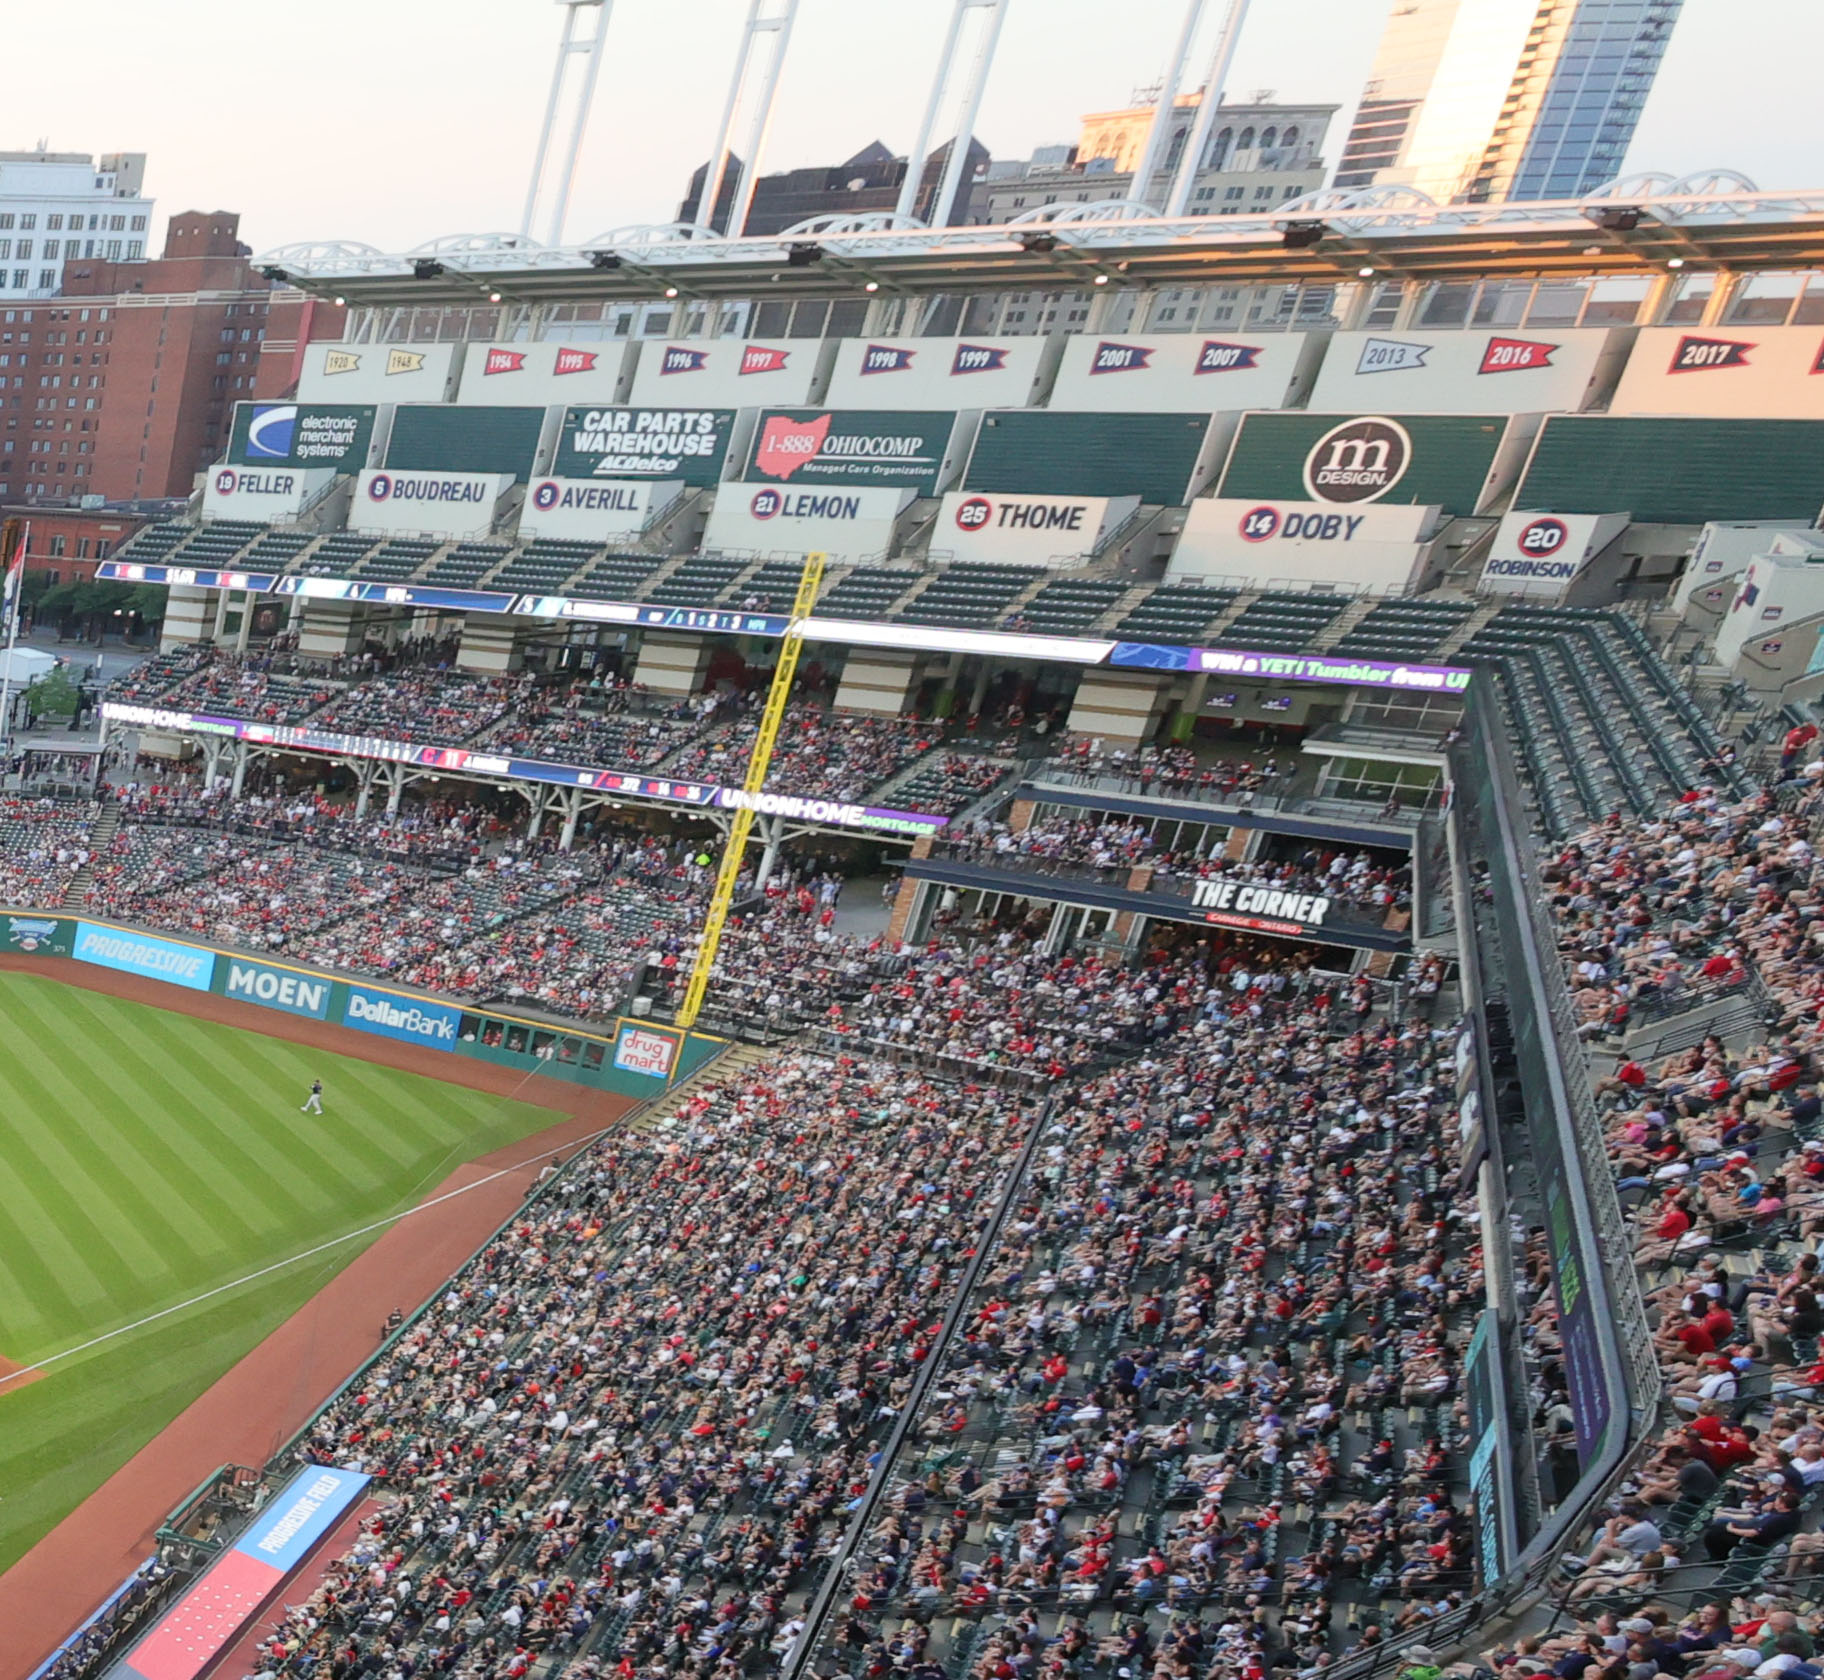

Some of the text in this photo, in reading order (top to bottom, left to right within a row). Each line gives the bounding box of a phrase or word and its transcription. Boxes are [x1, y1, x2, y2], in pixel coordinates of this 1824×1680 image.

[558, 354, 583, 370] 1995
[666, 352, 693, 370] 1996
[745, 351, 773, 369] 1997
[868, 351, 897, 368] 1998
[959, 350, 991, 368] 1999
[1098, 350, 1133, 367] 2001
[1201, 348, 1239, 367] 2007
[1366, 346, 1408, 365] 2013
[1489, 345, 1533, 364] 2016
[1682, 344, 1733, 364] 2017
[301, 414, 357, 430] electronic
[583, 411, 714, 433] CAR PARTS
[299, 429, 353, 444] merchant
[573, 432, 716, 456] WAREHOUSE
[766, 434, 924, 456] 1-888 OHIOCOMP
[296, 443, 345, 459] systems
[1321, 437, 1391, 471] m
[802, 462, 935, 476] Managed Care Organization
[218, 474, 294, 496] 19 FELLER
[374, 478, 487, 503] 5 BOUDREAU
[540, 486, 640, 511] 3 AVERILL
[755, 494, 862, 520] 21 LEMON
[959, 503, 1088, 532] 25 THOME
[1245, 513, 1366, 541] 14 DOBY
[1522, 527, 1562, 548] 20
[1485, 560, 1576, 578] ROBINSON
[1201, 651, 1245, 670] WIN
[1260, 656, 1305, 675] YETI
[1307, 661, 1392, 682] Tumbler
[1391, 666, 1444, 688] from
[860, 815, 937, 836] MORTGAGE
[1191, 880, 1330, 925] THE CORNER
[81, 933, 203, 978] PROGRESSIVE
[228, 965, 322, 1011] MOEN
[349, 994, 453, 1040] DollarBank
[624, 1030, 665, 1060] drug
[623, 1050, 669, 1073] mart
[257, 1473, 342, 1555] PROGRESSIVE FIELD
